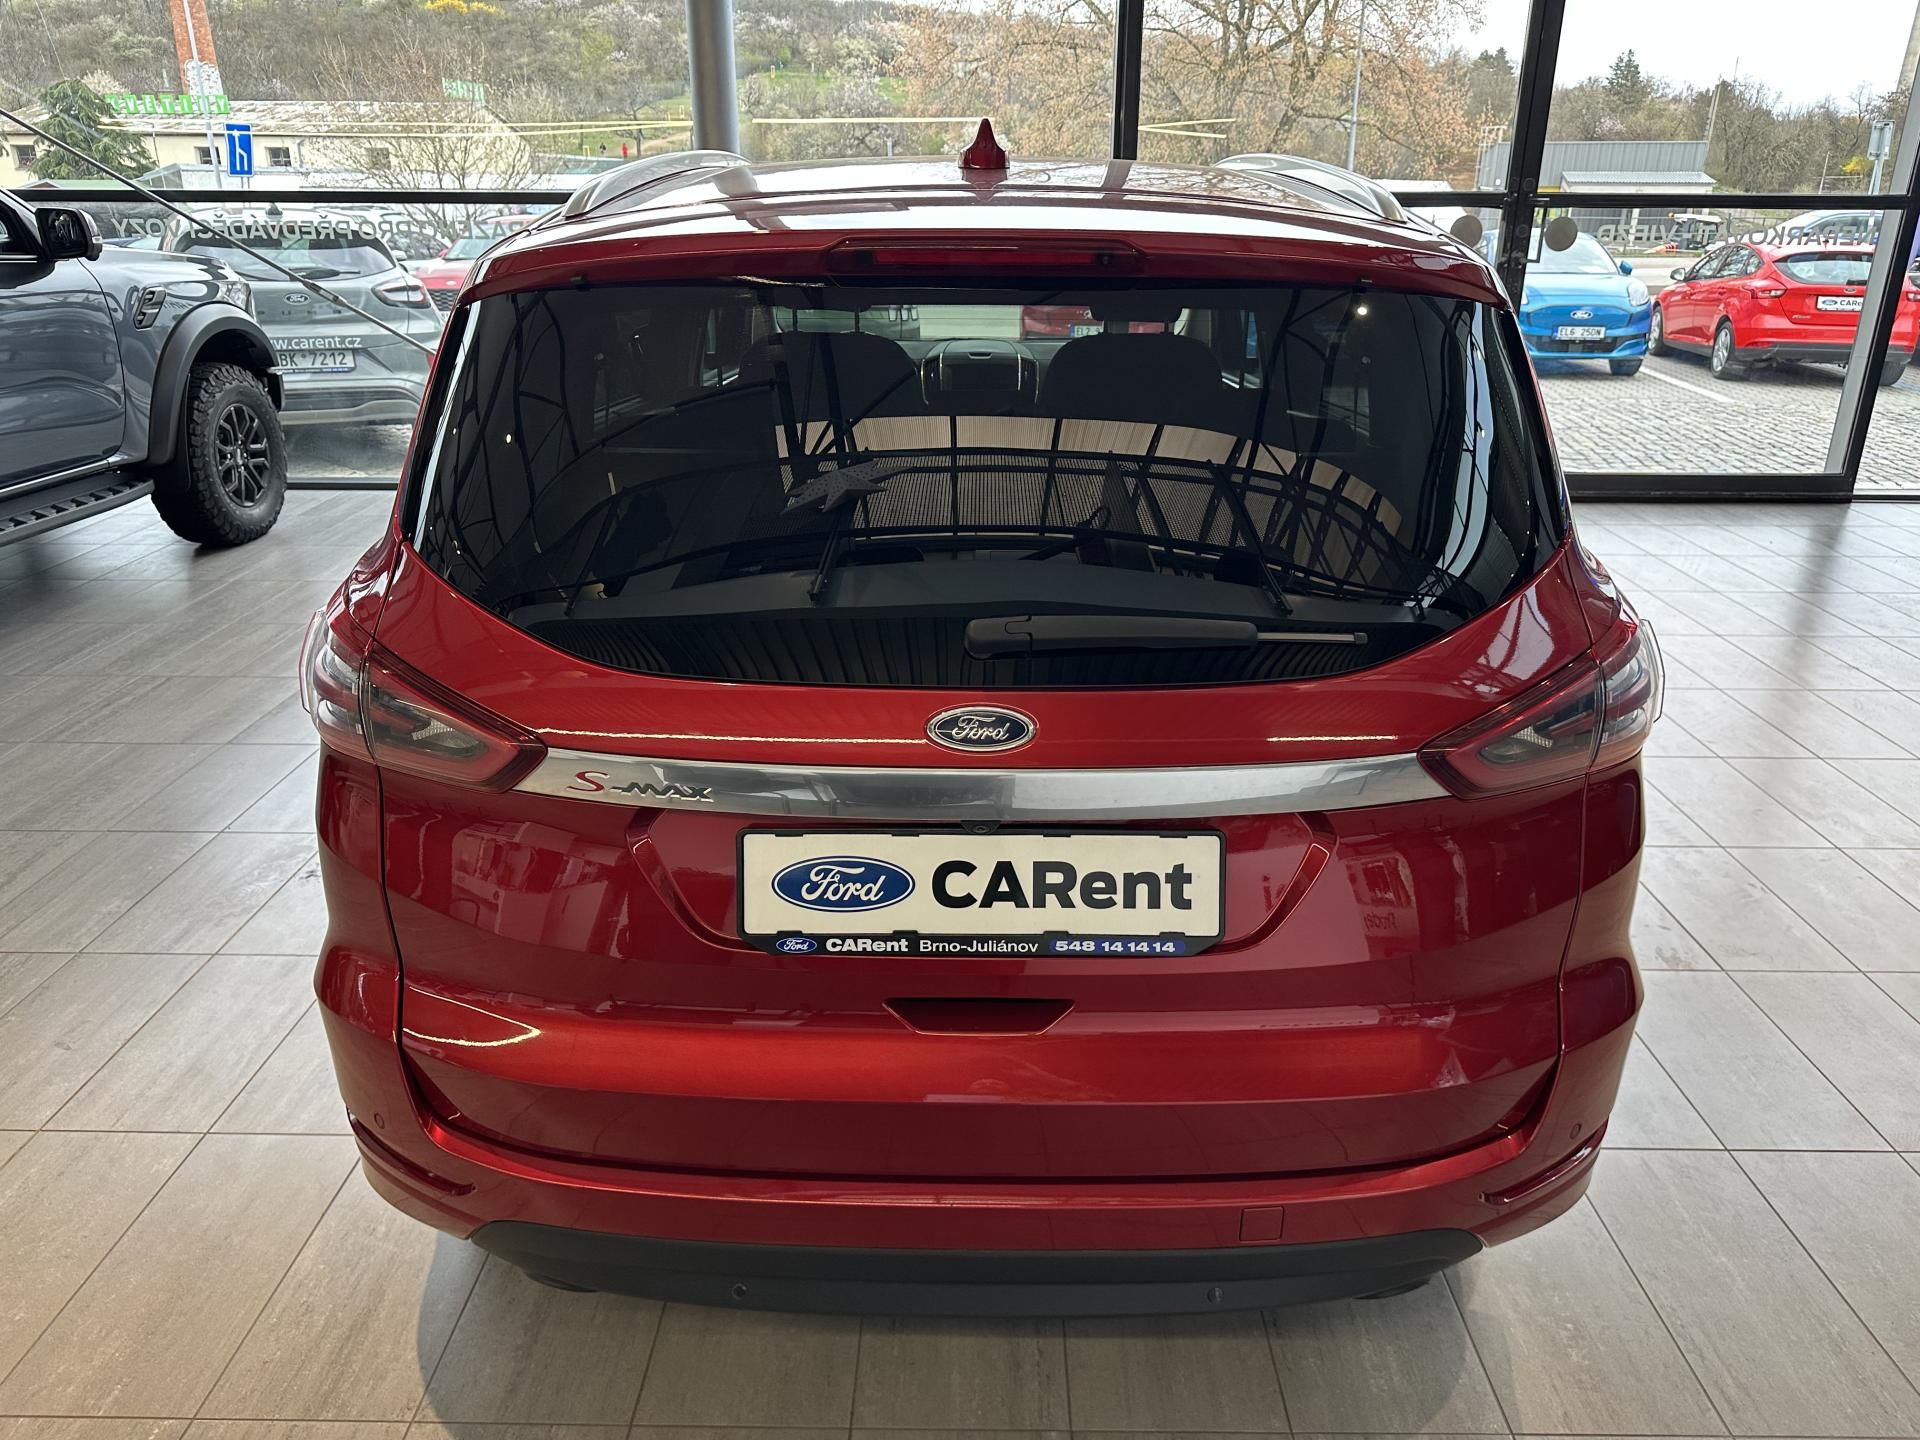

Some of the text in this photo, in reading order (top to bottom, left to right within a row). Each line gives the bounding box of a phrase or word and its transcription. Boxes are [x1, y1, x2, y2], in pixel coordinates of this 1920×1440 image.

[309, 352, 347, 366] 7212
[951, 715, 1011, 741] Ford
[565, 771, 714, 802] S-MAX
[801, 860, 1193, 910] Ford CARent
[783, 939, 809, 951] Ford
[825, 938, 909, 952] CARent
[919, 939, 1039, 953] Brno-Juliánov
[1055, 940, 1096, 952] 548
